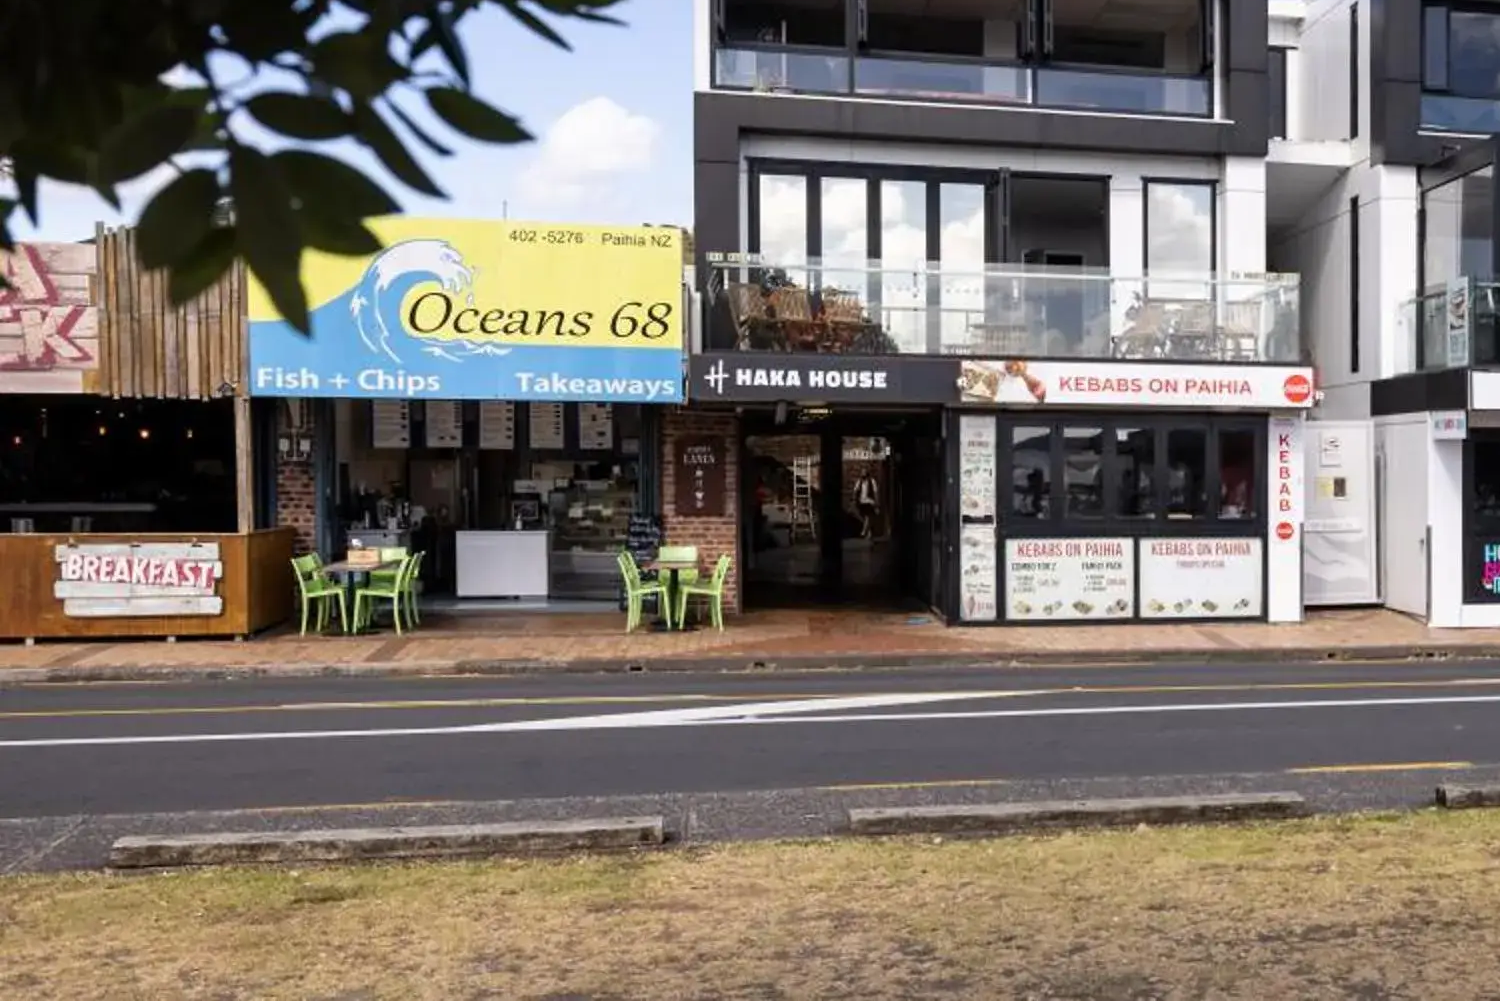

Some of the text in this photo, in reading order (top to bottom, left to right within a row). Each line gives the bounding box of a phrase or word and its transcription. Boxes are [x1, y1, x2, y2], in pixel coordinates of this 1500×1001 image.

[508, 230, 537, 243] 402
[601, 232, 646, 247] Paihia
[650, 234, 673, 248] NZ
[408, 292, 673, 340] Oceans 68
[256, 367, 676, 399] Fish + Chips Takeaways
[735, 368, 888, 389] HAKA HOUSE
[1058, 376, 1252, 395] KEBABS ON PAIHIA
[1279, 434, 1292, 512] KEBAB
[1017, 542, 1123, 558] KEBABS ON PAIHIA
[1151, 541, 1252, 556] KEBABS ON PAIHIA
[67, 554, 214, 589] BREAKFAST
